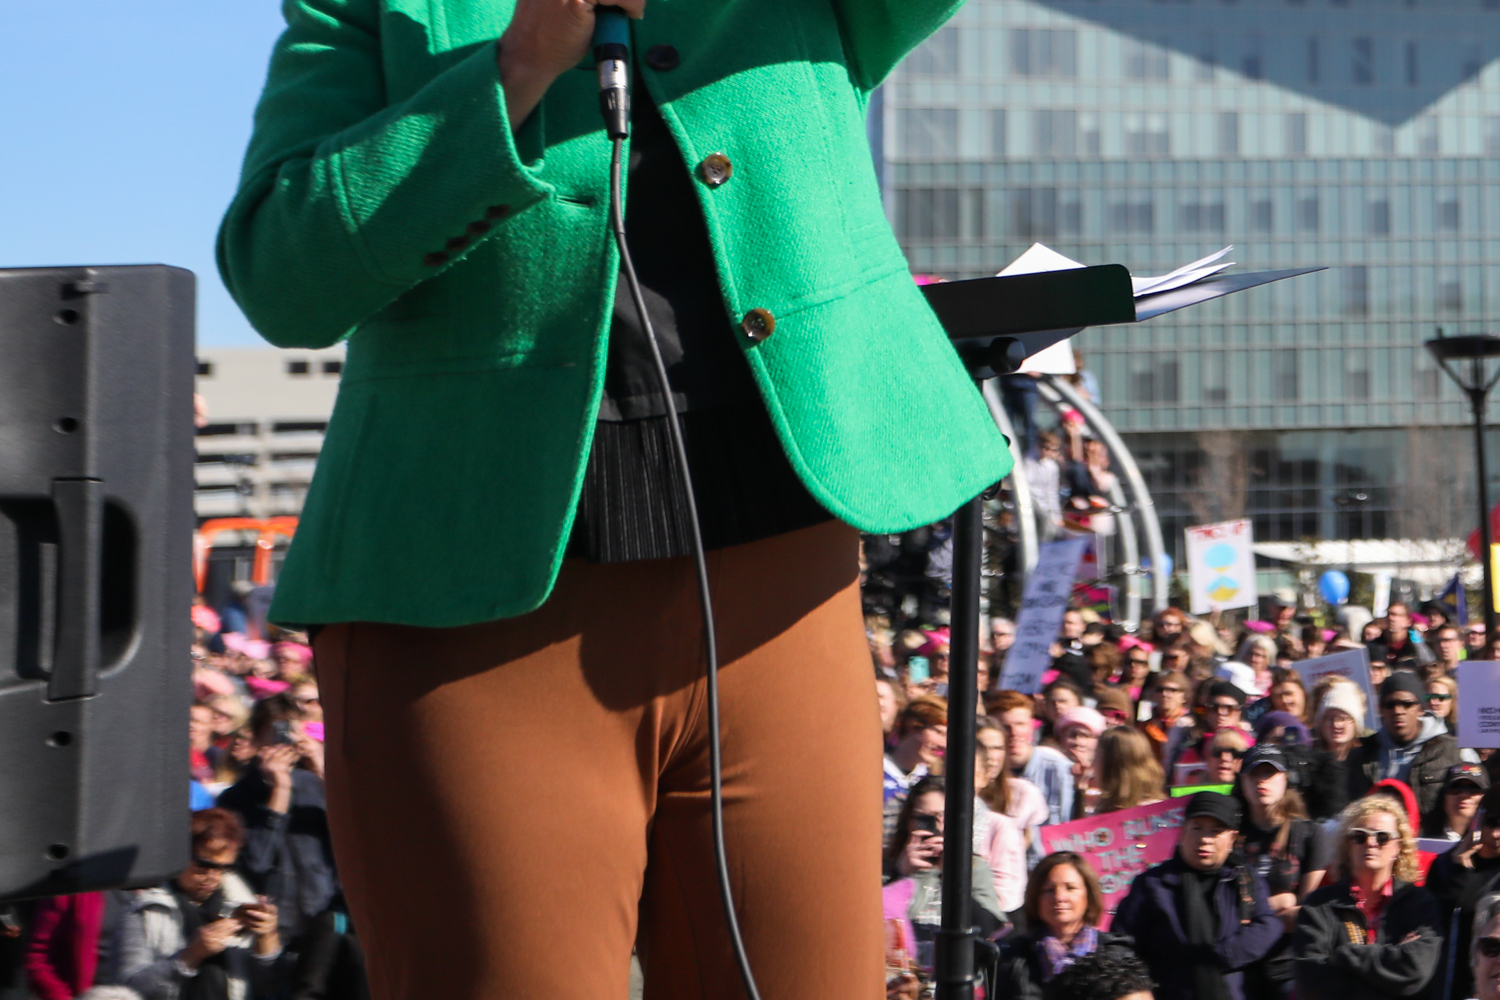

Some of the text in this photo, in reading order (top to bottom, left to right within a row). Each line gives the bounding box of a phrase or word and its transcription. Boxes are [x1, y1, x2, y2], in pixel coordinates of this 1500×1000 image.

[1051, 806, 1187, 853] WHO RUNS
[1096, 845, 1145, 872] THE
